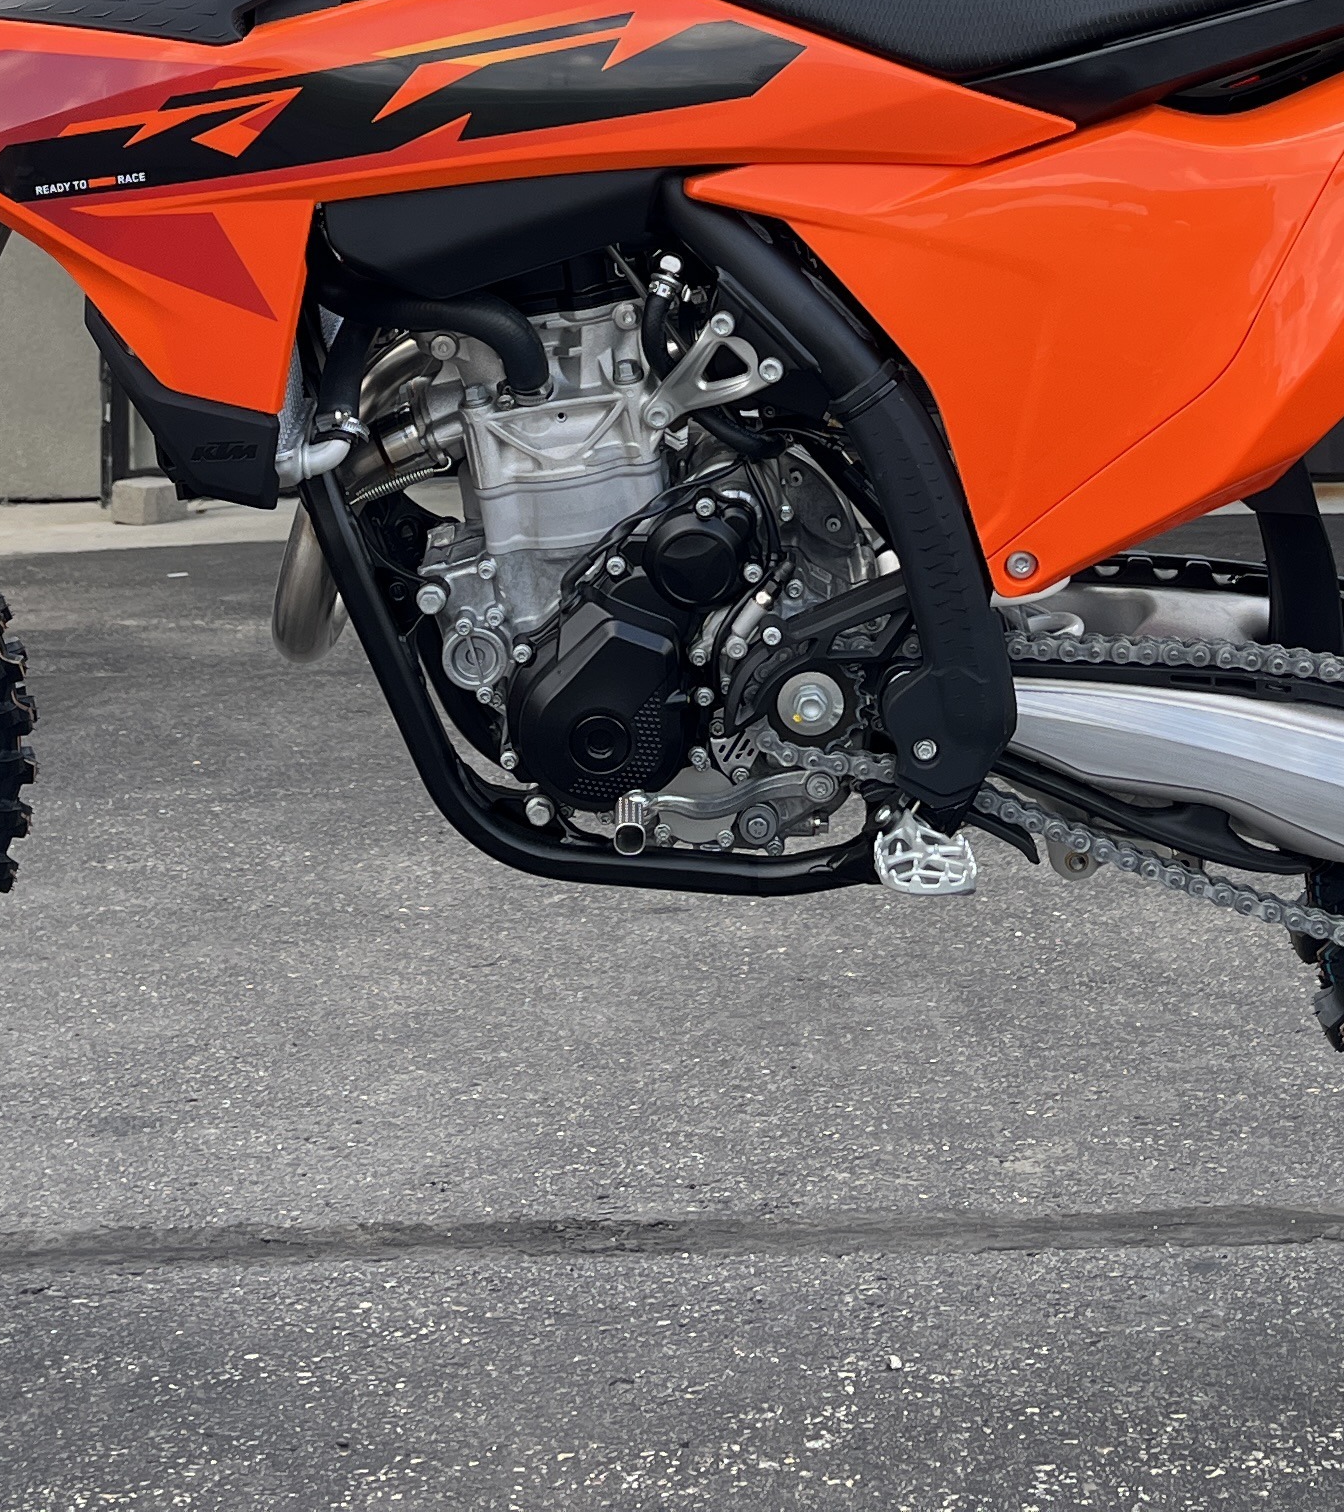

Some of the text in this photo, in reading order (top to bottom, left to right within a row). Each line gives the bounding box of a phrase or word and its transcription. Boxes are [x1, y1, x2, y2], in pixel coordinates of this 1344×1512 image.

[35, 171, 146, 196] READY TO RACE
[190, 439, 258, 463] KTM
